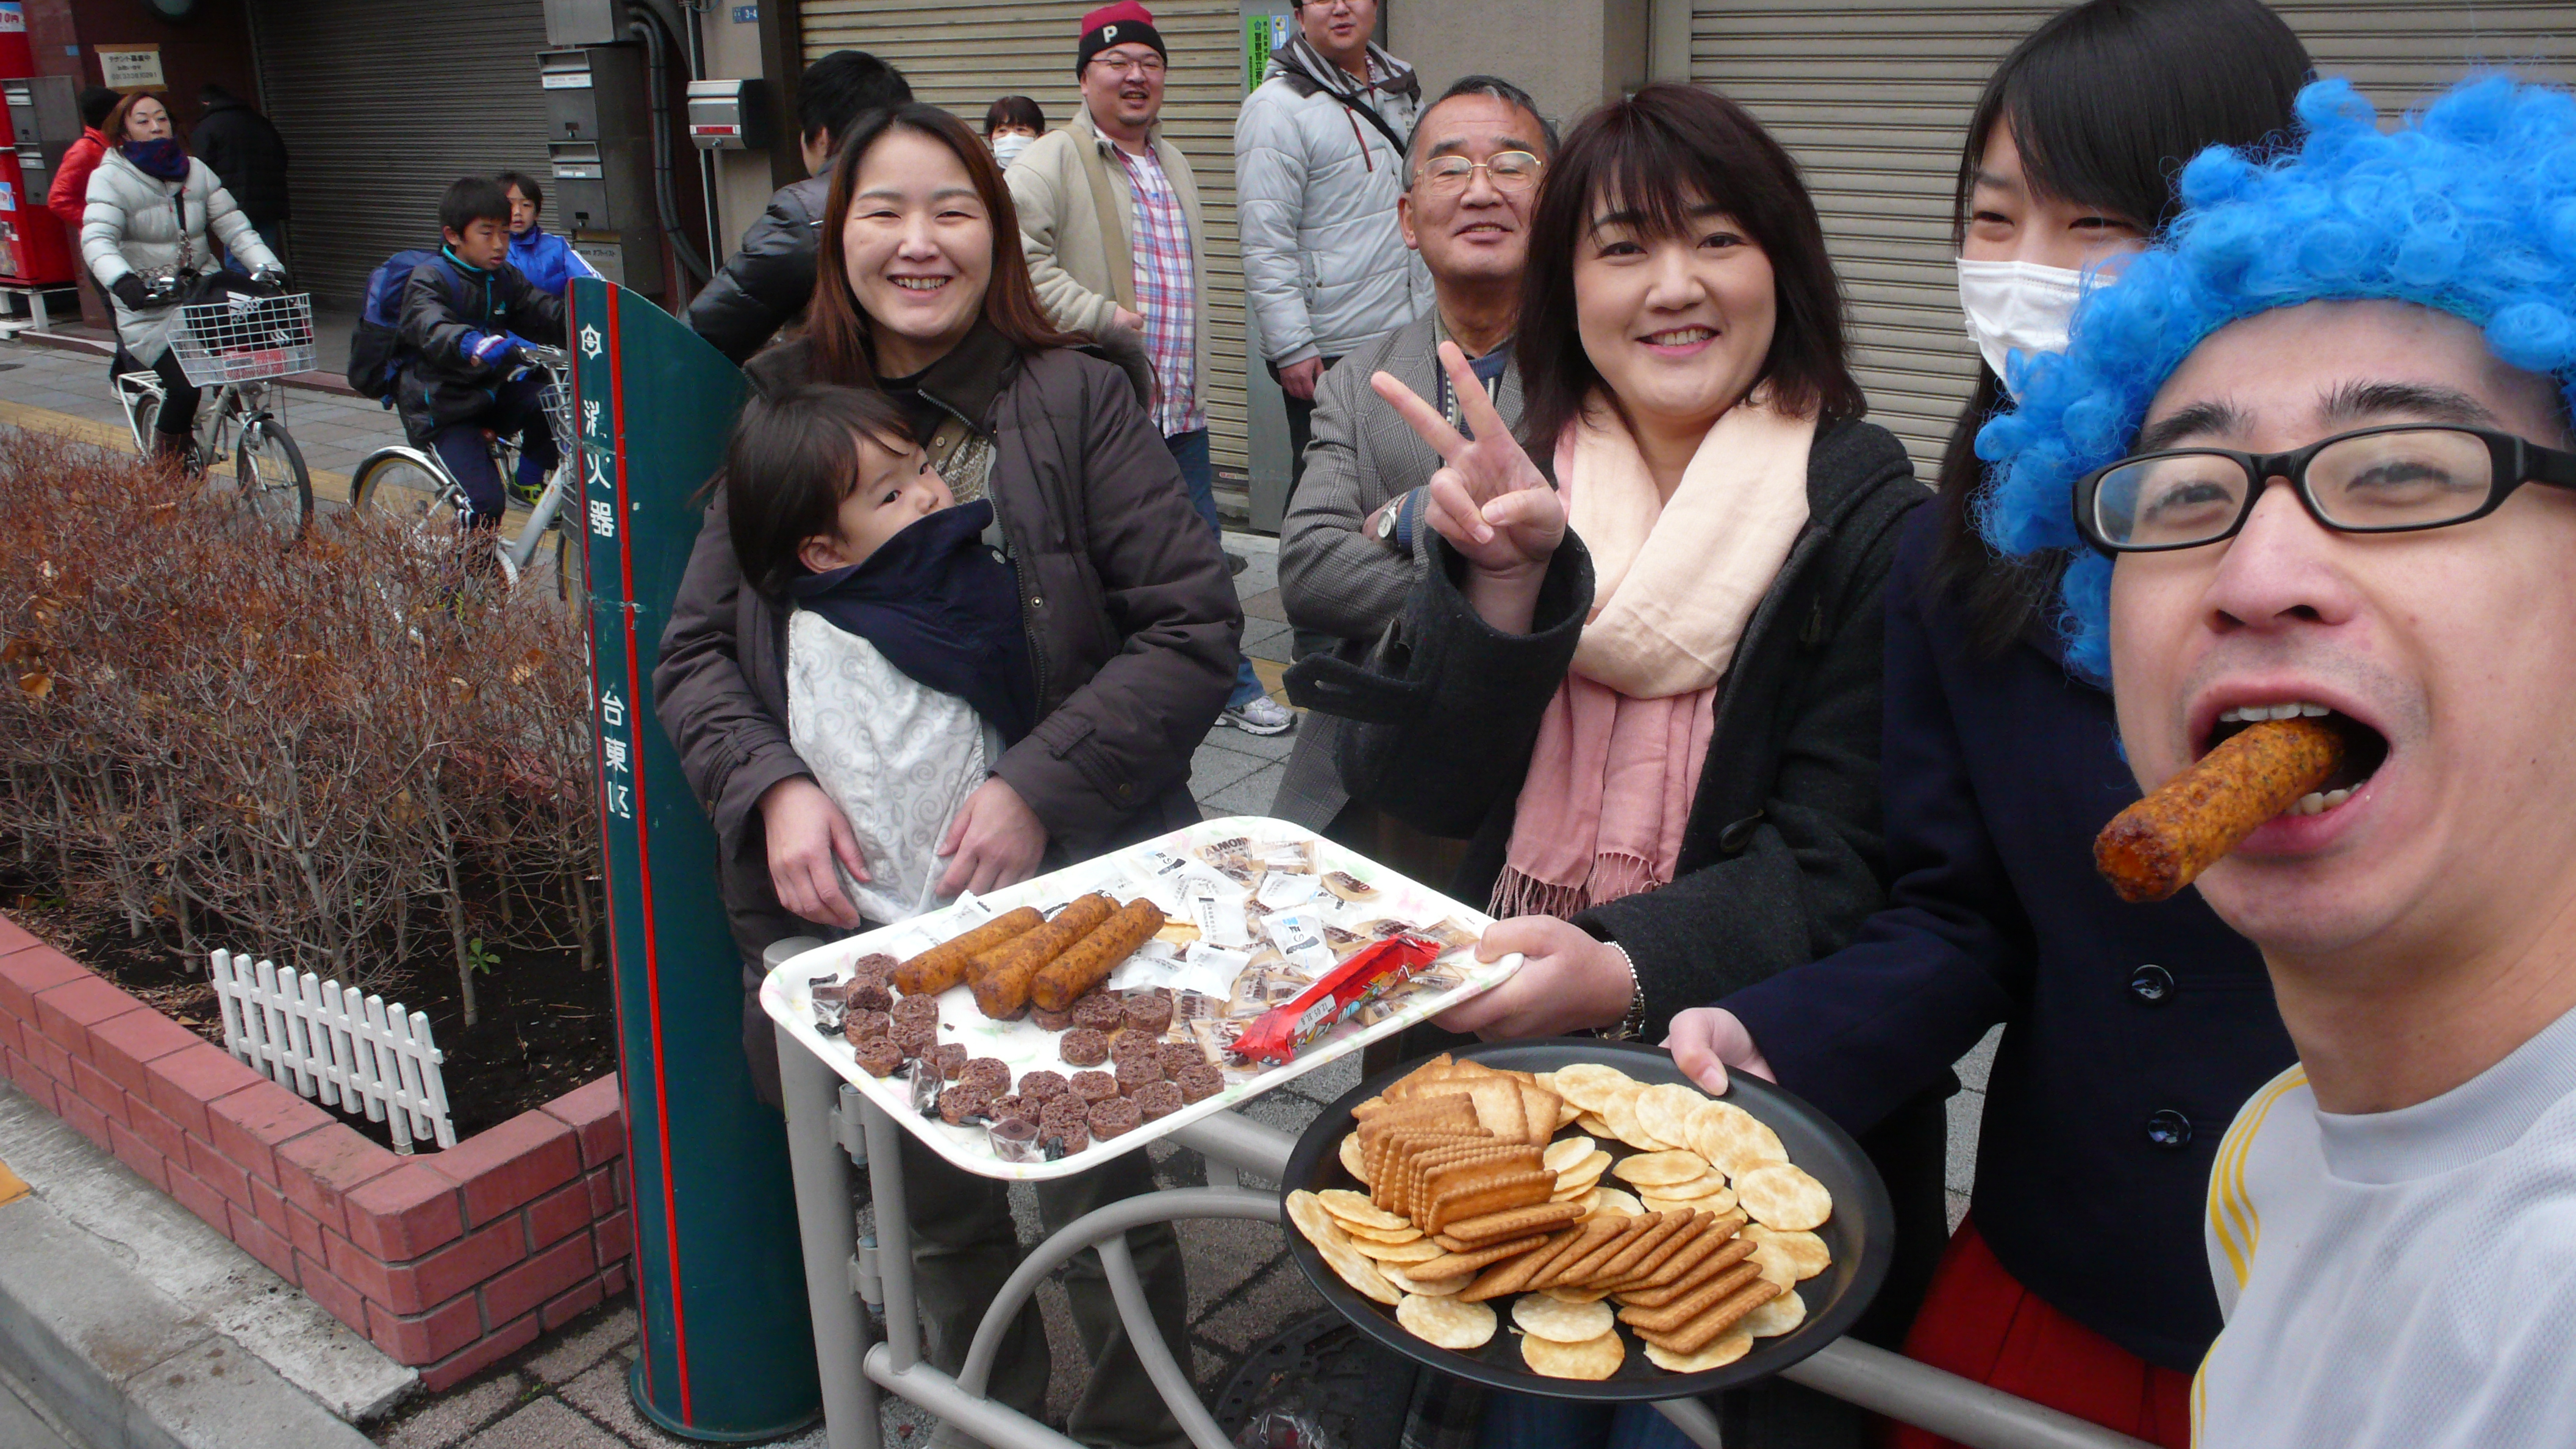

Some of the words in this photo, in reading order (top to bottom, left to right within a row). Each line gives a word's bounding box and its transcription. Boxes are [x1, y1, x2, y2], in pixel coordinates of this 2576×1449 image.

[1103, 25, 1118, 43] P
[602, 690, 631, 820] 台東区
[1205, 837, 1248, 857] ALMON
